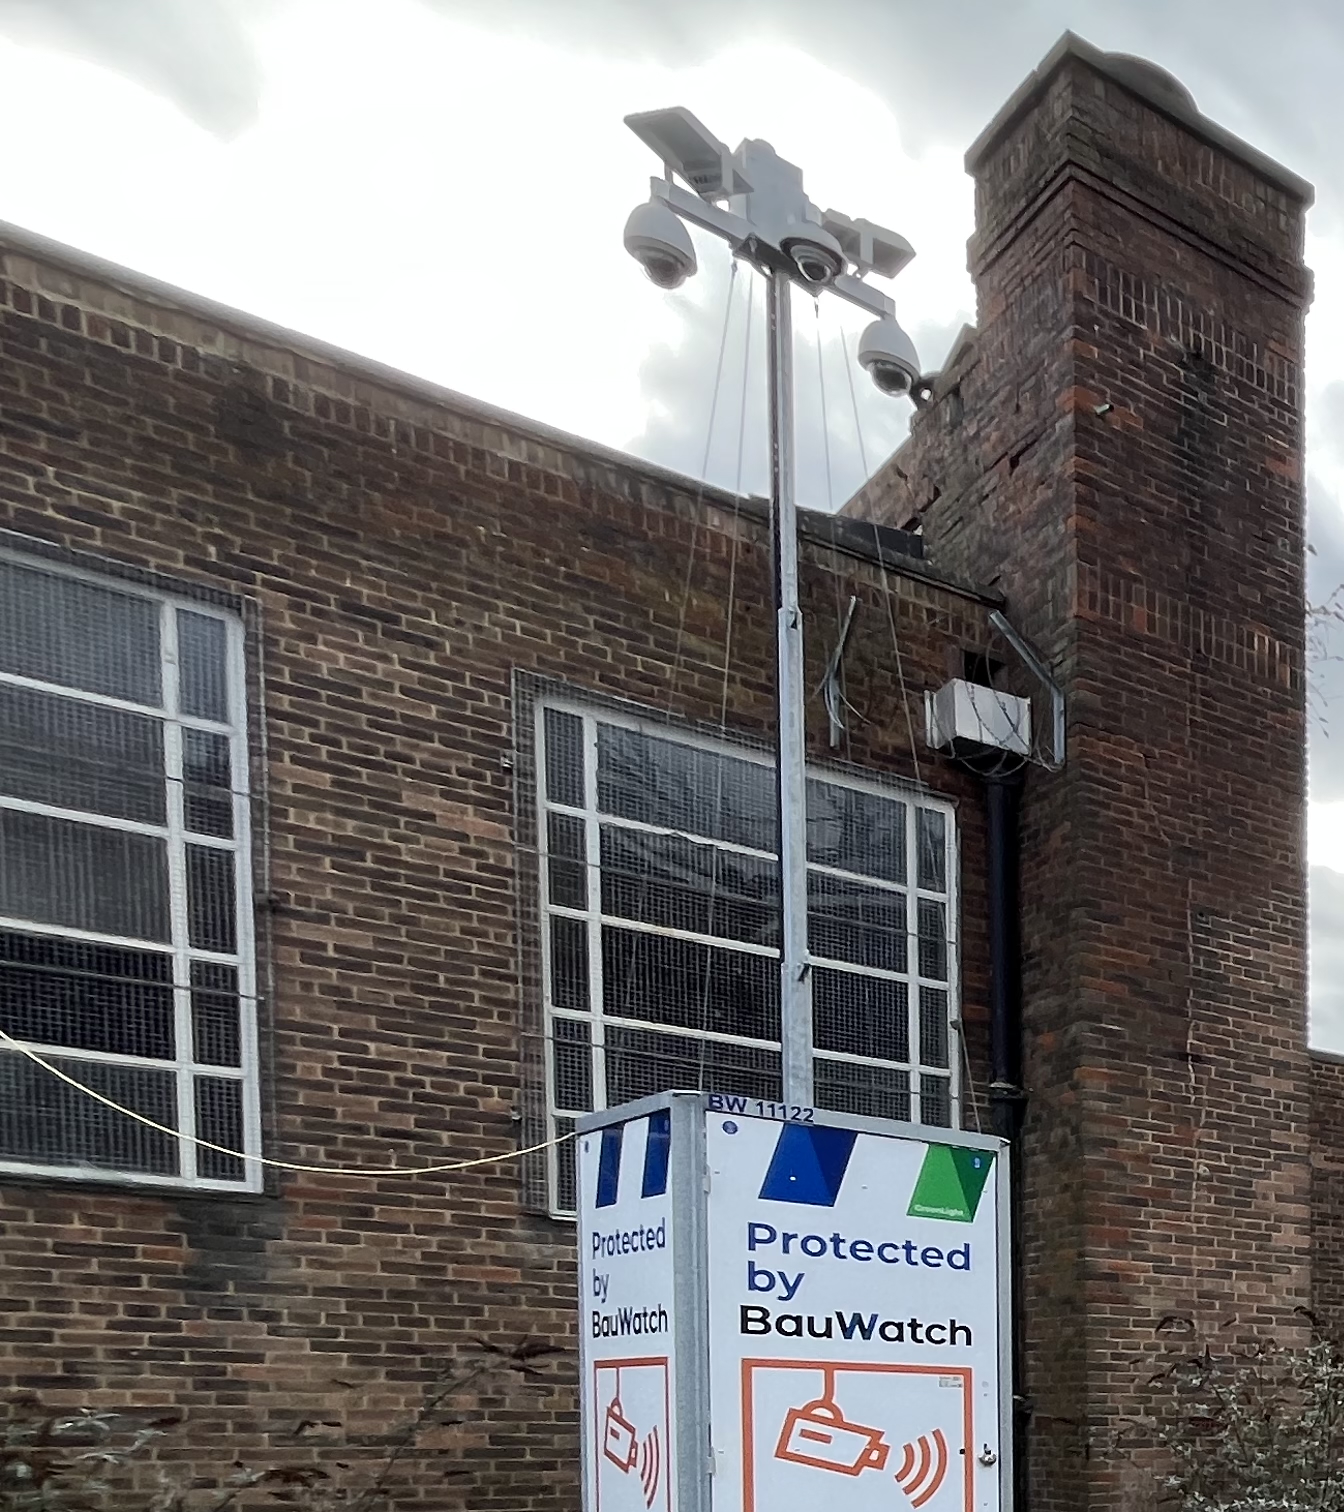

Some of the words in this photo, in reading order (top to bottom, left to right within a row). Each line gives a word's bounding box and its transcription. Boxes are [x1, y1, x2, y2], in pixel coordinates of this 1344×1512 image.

[708, 1093, 748, 1113] BW
[756, 1101, 815, 1122] 11122
[592, 1216, 666, 1260] Protected
[747, 1221, 971, 1271] Protected
[592, 1267, 610, 1304] by
[747, 1259, 805, 1301] by
[592, 1303, 668, 1338] BauWatch
[739, 1304, 973, 1346] BauWatch
